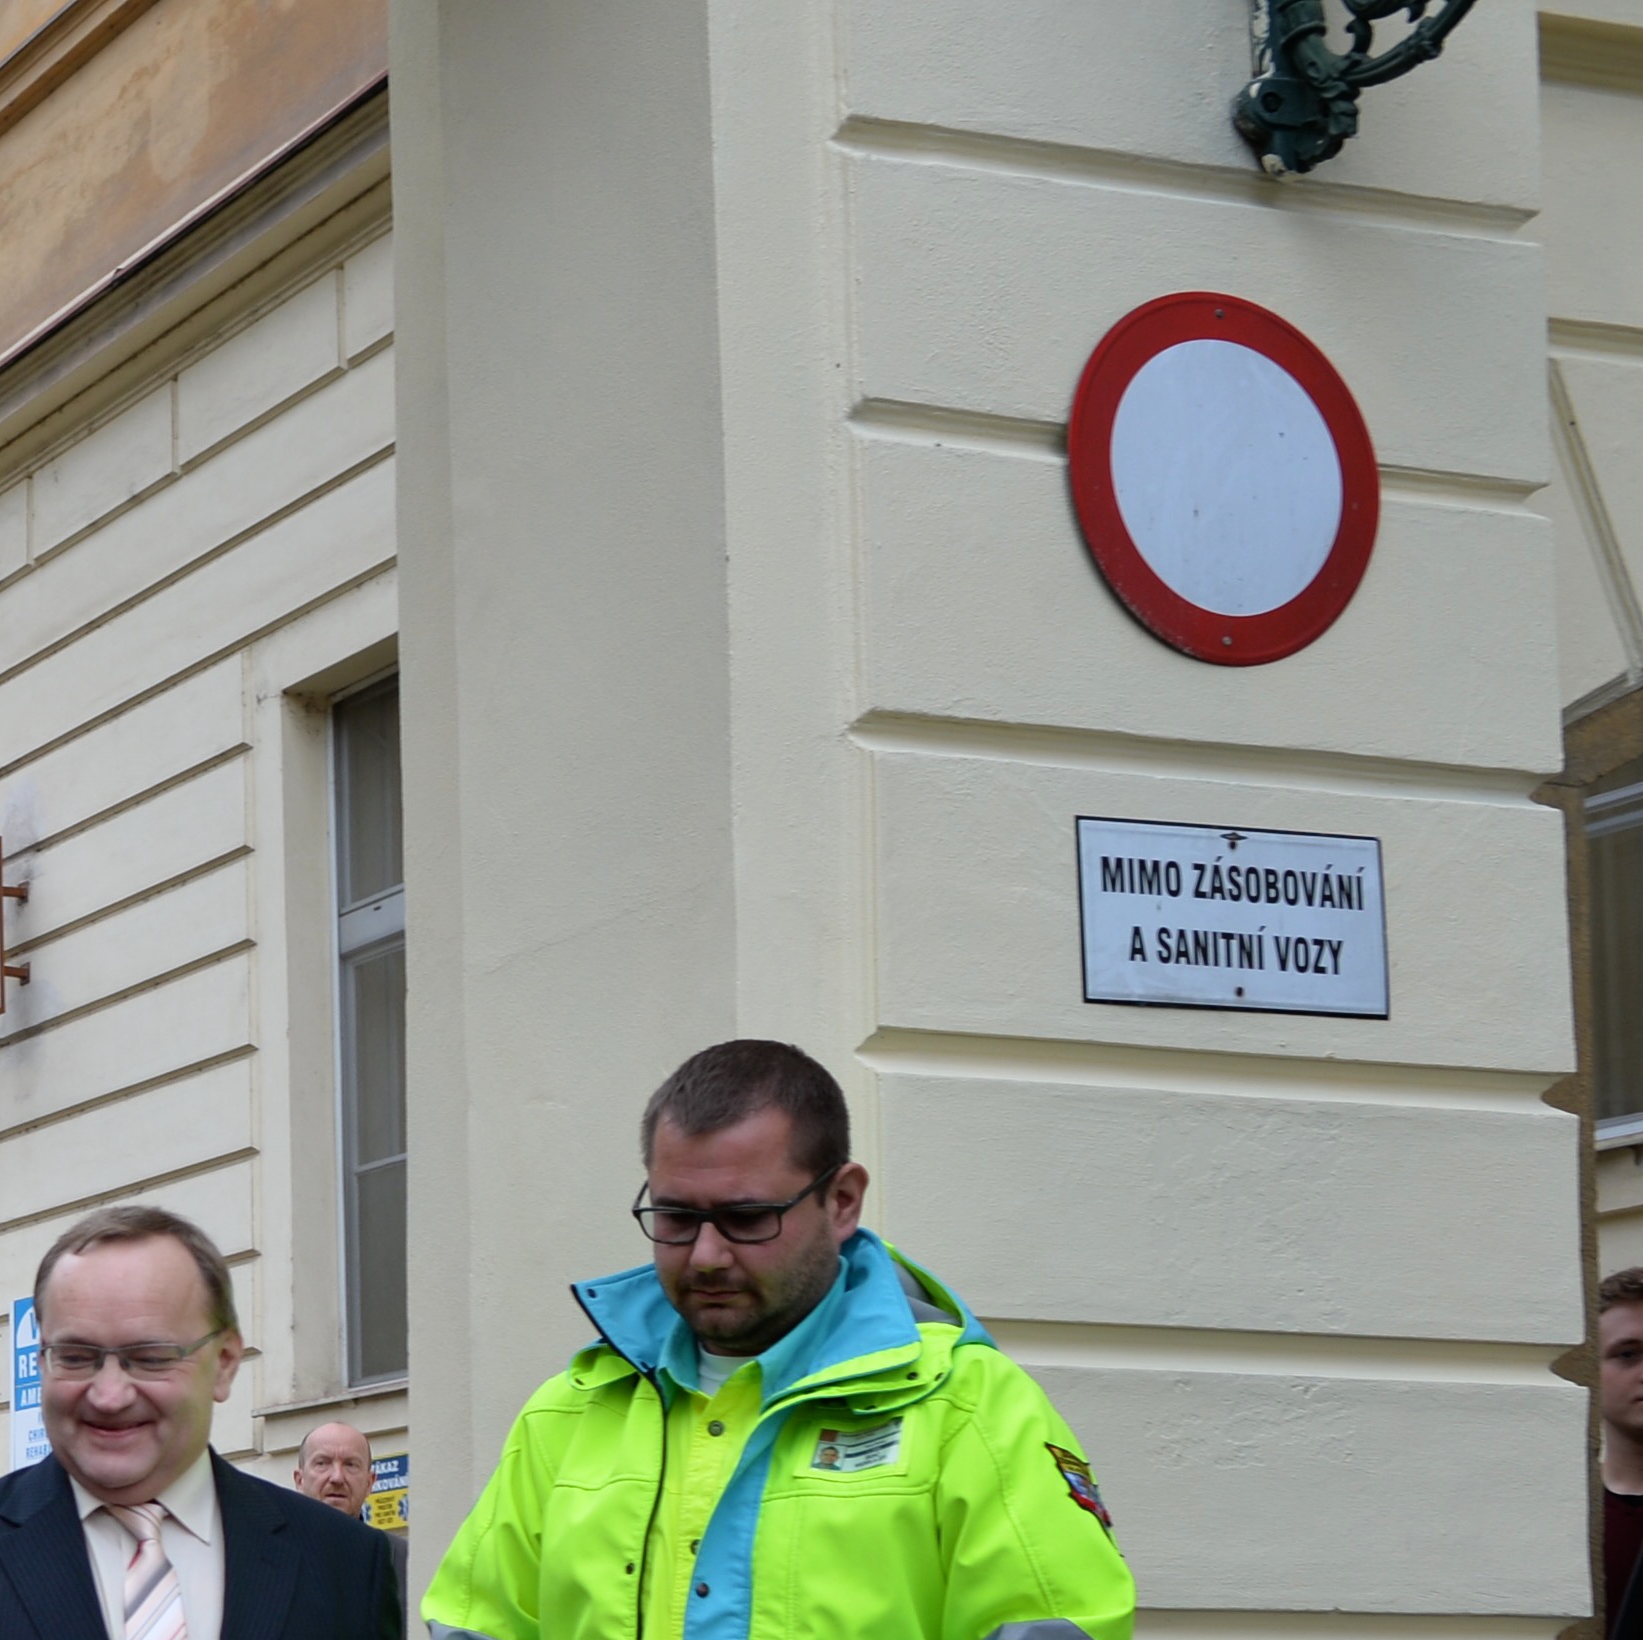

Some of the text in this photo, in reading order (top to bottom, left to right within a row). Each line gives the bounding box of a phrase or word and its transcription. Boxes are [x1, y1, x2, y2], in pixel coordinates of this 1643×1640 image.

[1101, 855, 1366, 911] MIMO ZÁSOBOVÁNÍ
[1128, 926, 1344, 976] A SANITNÍ VOZY
